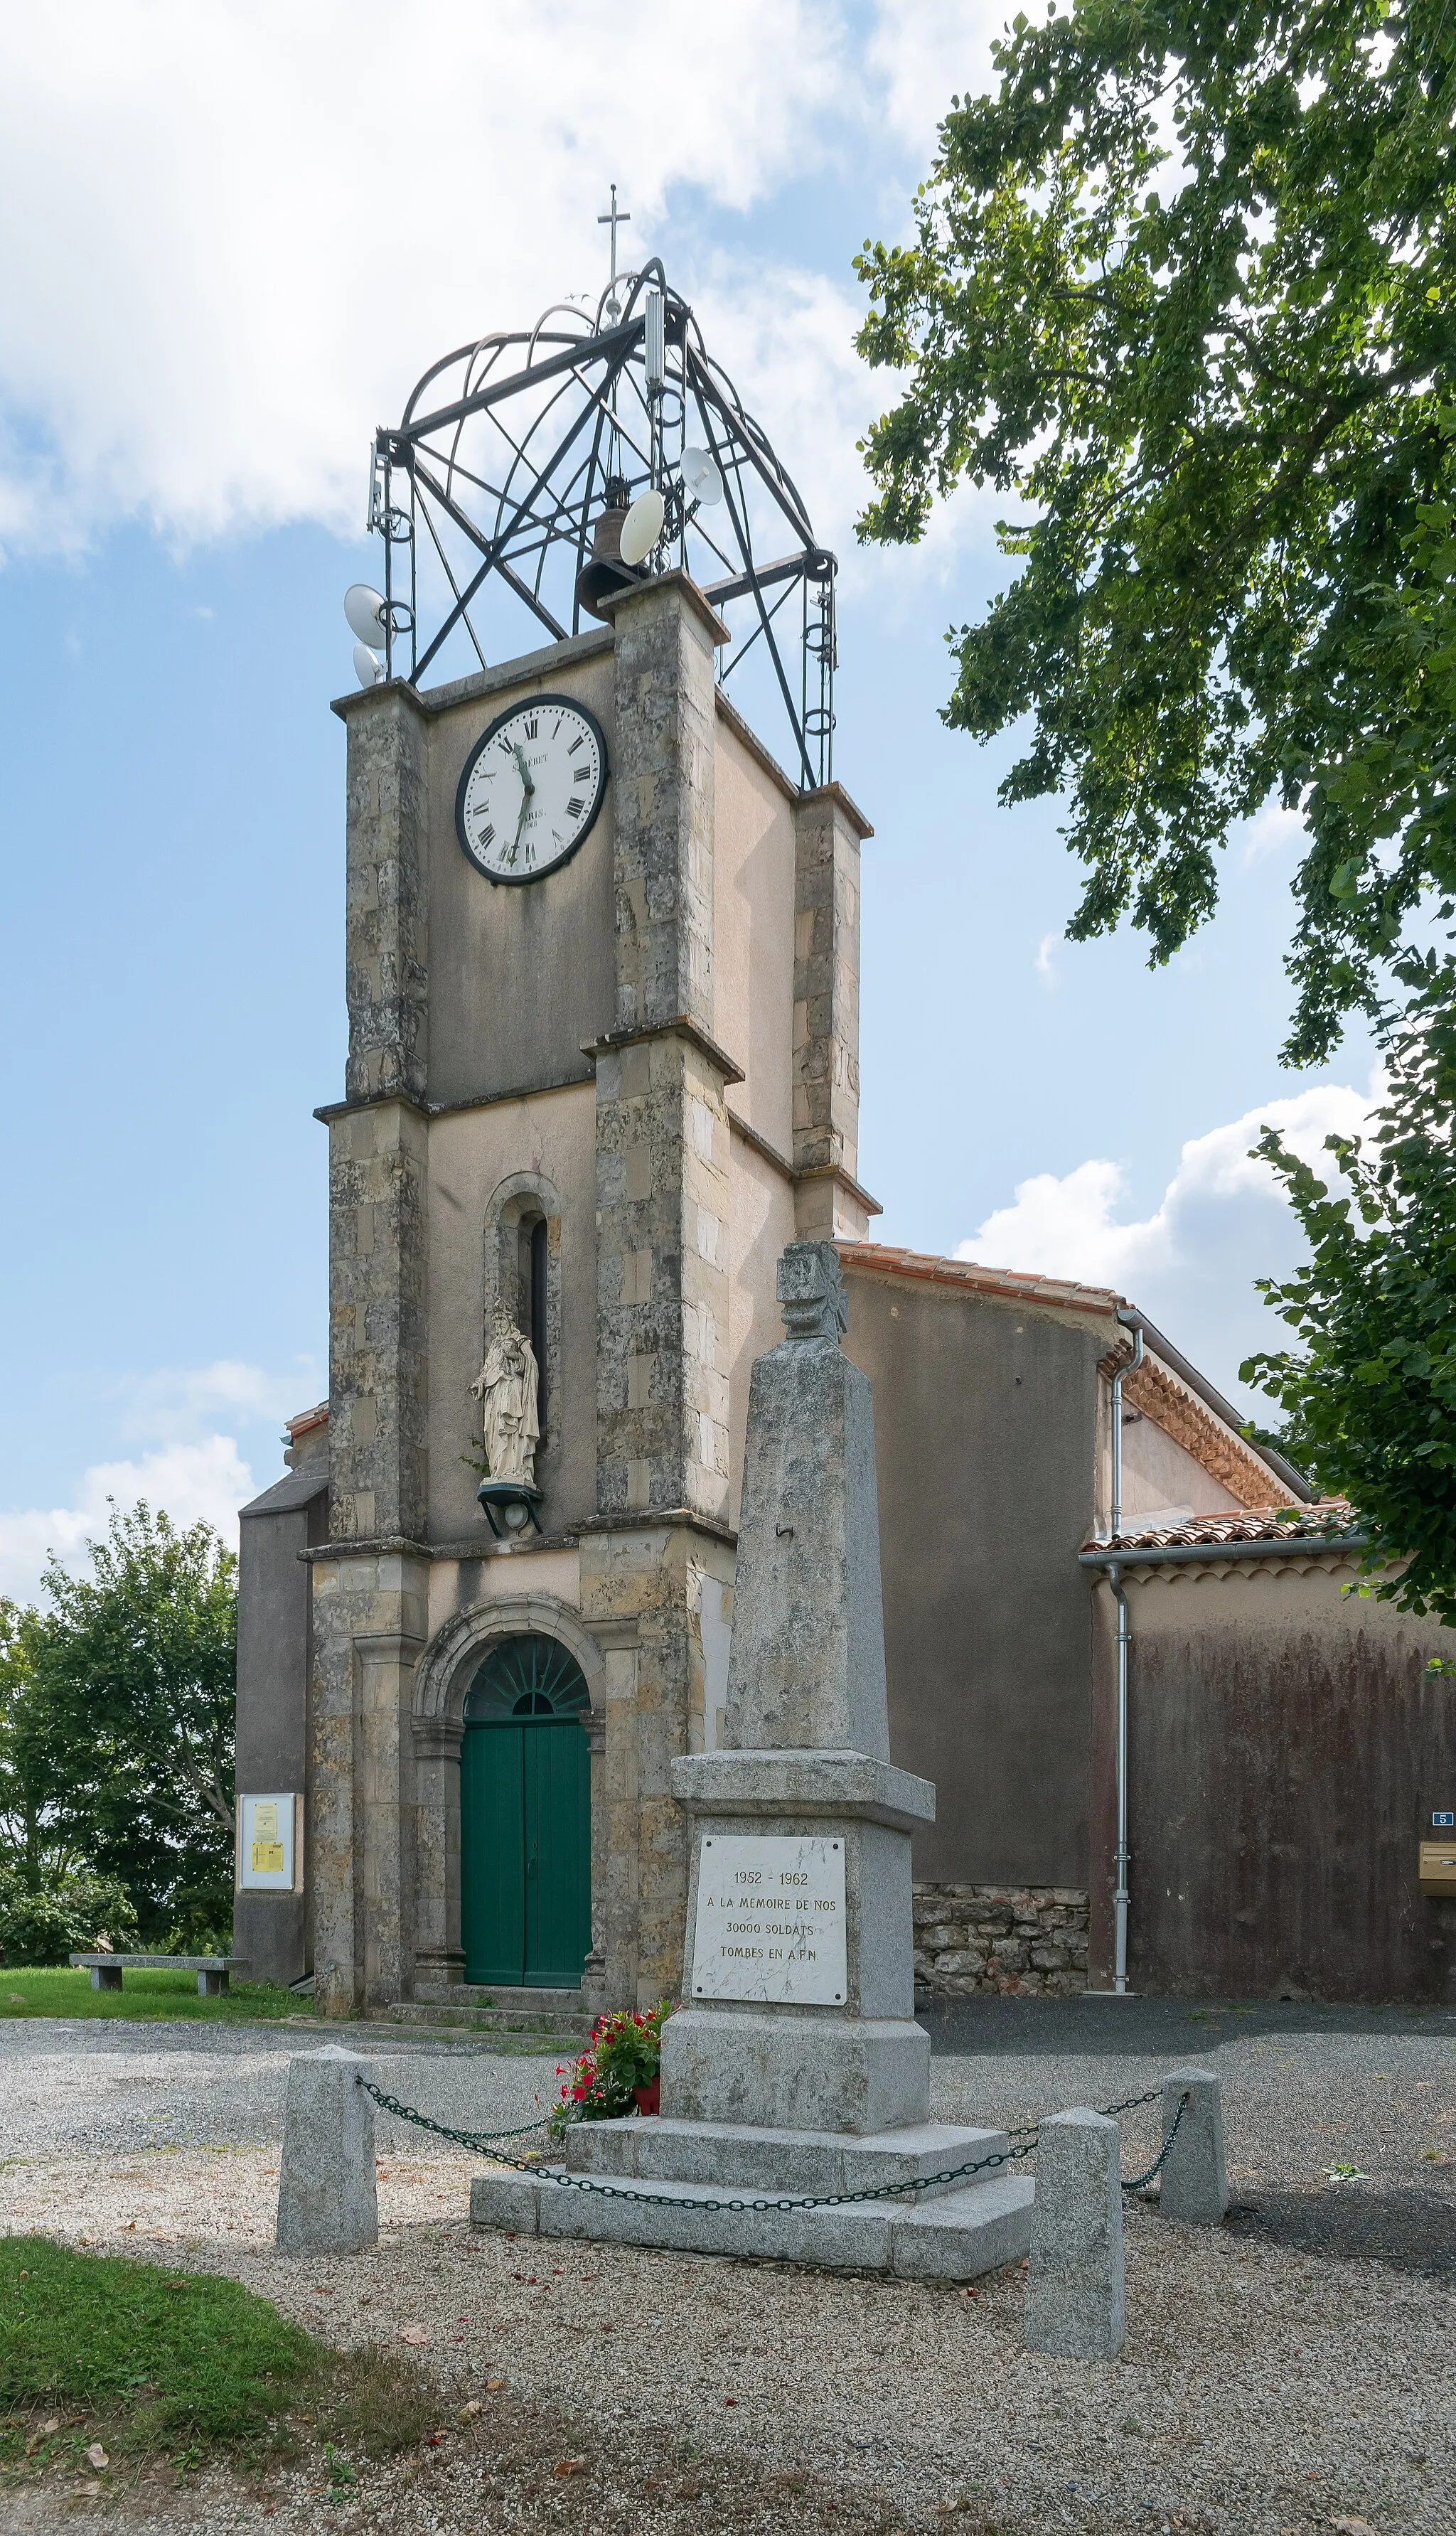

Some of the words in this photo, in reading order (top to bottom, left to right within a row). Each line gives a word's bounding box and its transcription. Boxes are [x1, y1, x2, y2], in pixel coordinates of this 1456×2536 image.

[523, 718, 539, 744] XII
[550, 719, 562, 739] I
[567, 734, 584, 756] II
[478, 766, 497, 785] X
[573, 764, 591, 783] III
[524, 809, 547, 823] RIS.
[564, 796, 586, 819] IIII
[552, 828, 564, 847] V
[1440, 1814, 1447, 1824] 5
[734, 1871, 762, 1884] 1952
[779, 1872, 808, 1885] 1962
[707, 1897, 714, 1907] A
[720, 1898, 734, 1908] LA
[739, 1898, 791, 1910] MEMOIRE
[796, 1900, 809, 1910] DE
[814, 1900, 836, 1911] NOS
[726, 1922, 761, 1934] 30000
[765, 1924, 814, 1936] SOLDATS
[720, 1946, 764, 1958] TOMBES
[769, 1949, 783, 1959] EN
[788, 1950, 819, 1961] A.F.N.
